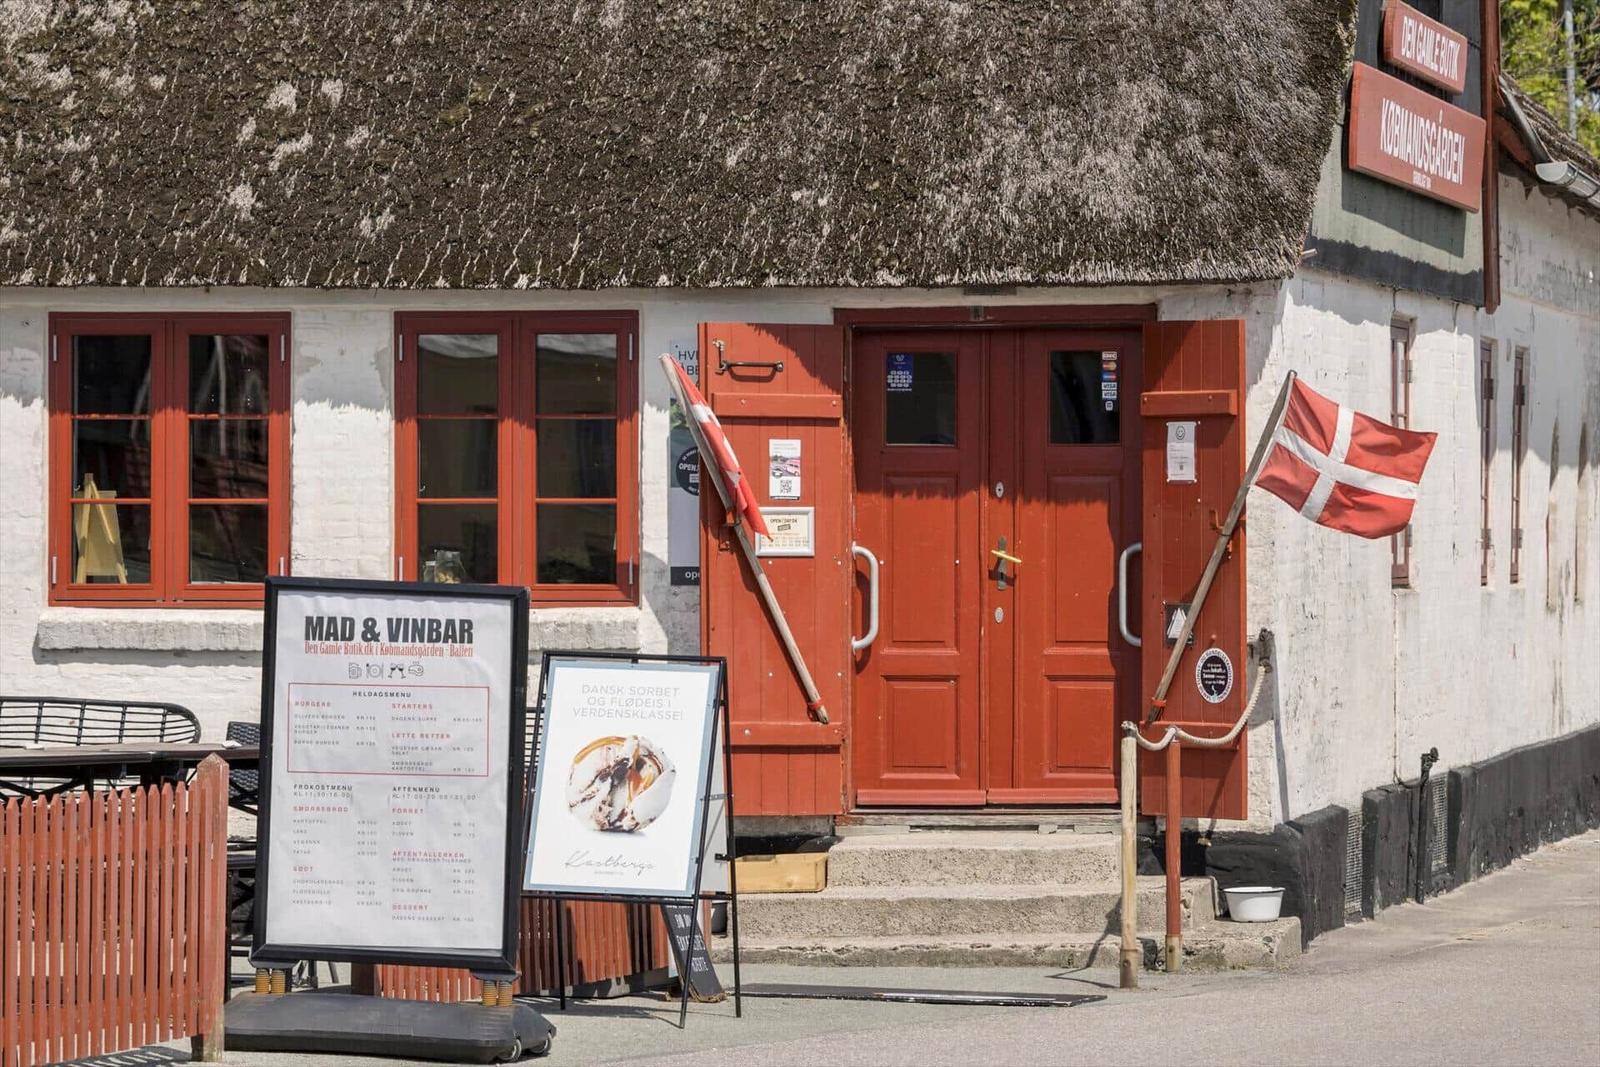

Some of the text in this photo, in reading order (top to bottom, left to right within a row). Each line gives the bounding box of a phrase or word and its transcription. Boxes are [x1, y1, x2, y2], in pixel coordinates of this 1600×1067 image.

[1402, 16, 1461, 81] DEN GAMLE BUTIK
[1380, 97, 1466, 185] KØBMANDSGÅRDEN
[305, 616, 474, 644] MAD & VINBAR
[304, 642, 318, 654] Den
[319, 642, 342, 655] Gamle
[581, 684, 680, 697] DANSK SORBET
[587, 696, 606, 706] OG
[611, 697, 663, 708] FLØDEIS
